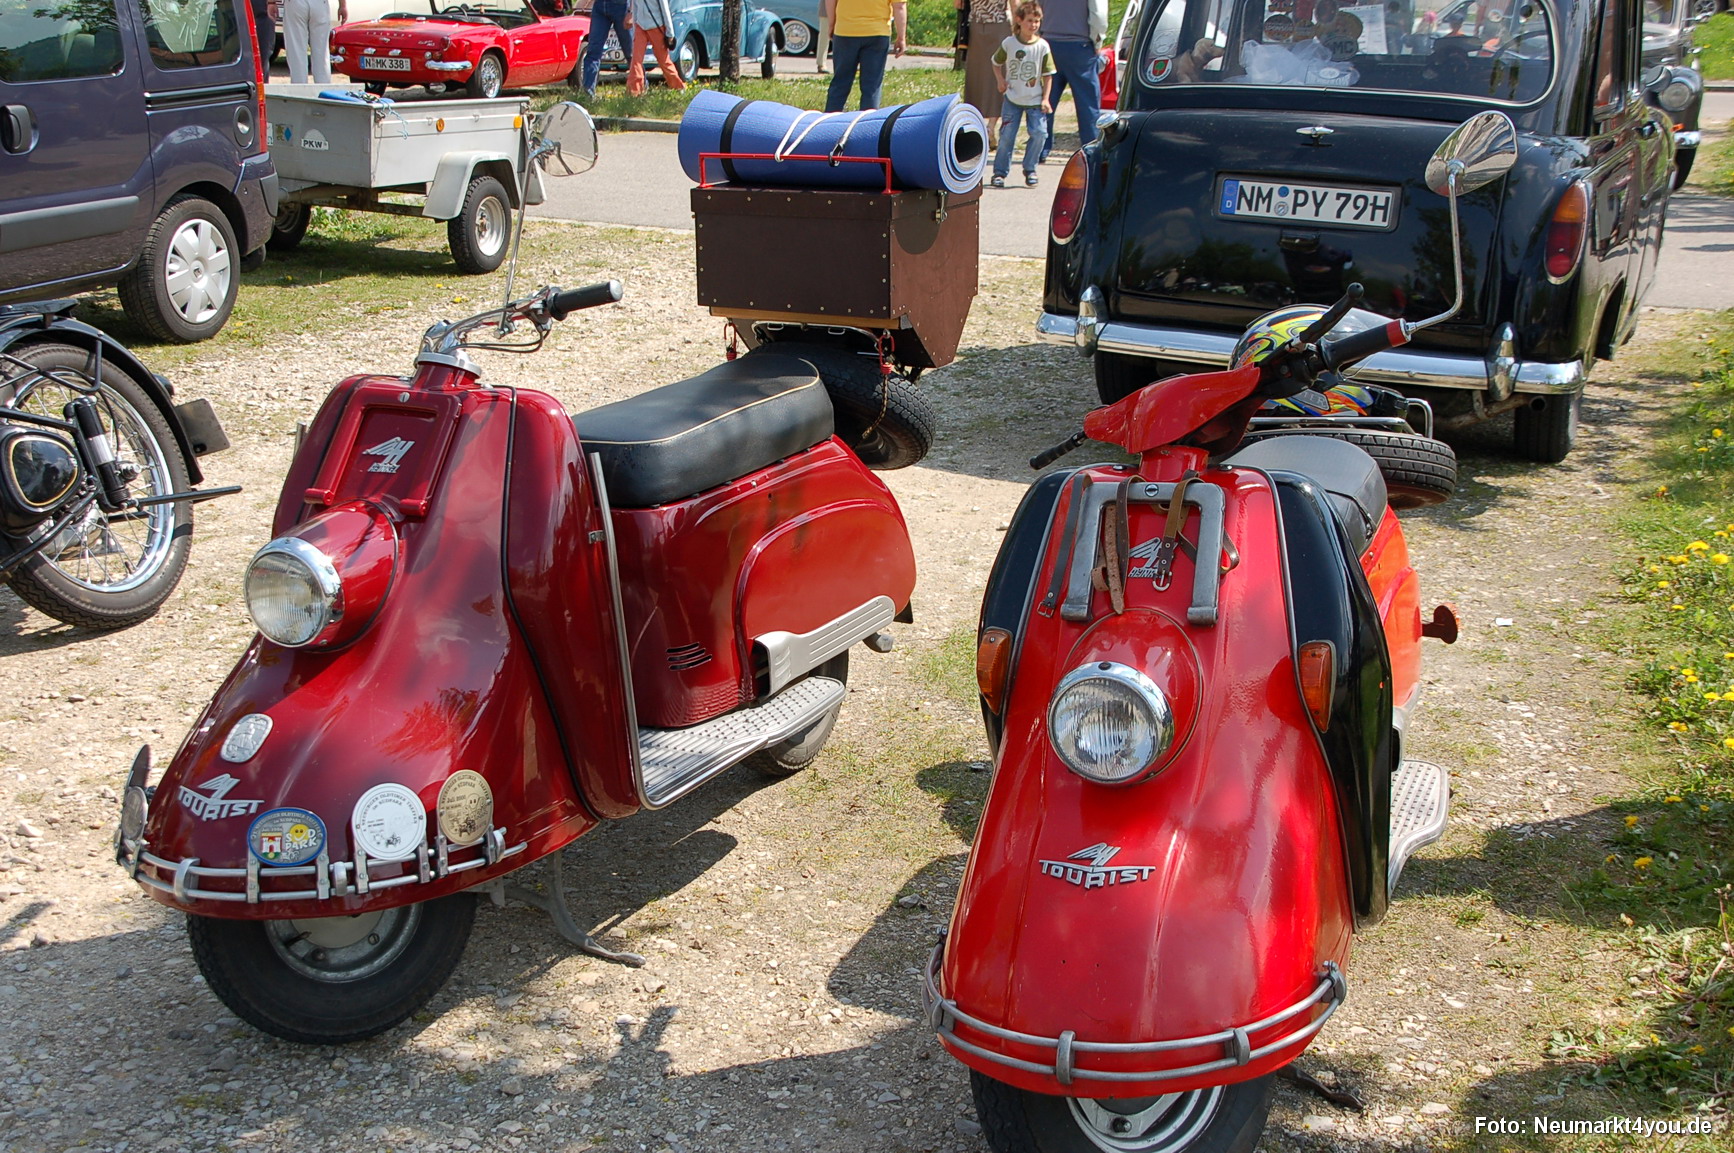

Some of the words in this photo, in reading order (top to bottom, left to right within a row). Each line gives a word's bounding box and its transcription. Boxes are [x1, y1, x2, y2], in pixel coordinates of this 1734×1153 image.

[365, 58, 371, 68] N
[388, 60, 404, 69] 338
[1009, 59, 1037, 82] 29
[303, 139, 323, 149] PKW
[1225, 200, 1232, 208] D
[1236, 185, 1274, 213] NM
[1291, 189, 1329, 217] PY
[1335, 192, 1391, 223] 79H
[179, 785, 265, 822] TOURIST
[285, 836, 317, 850] PARK
[1039, 860, 1156, 889] TOURIST
